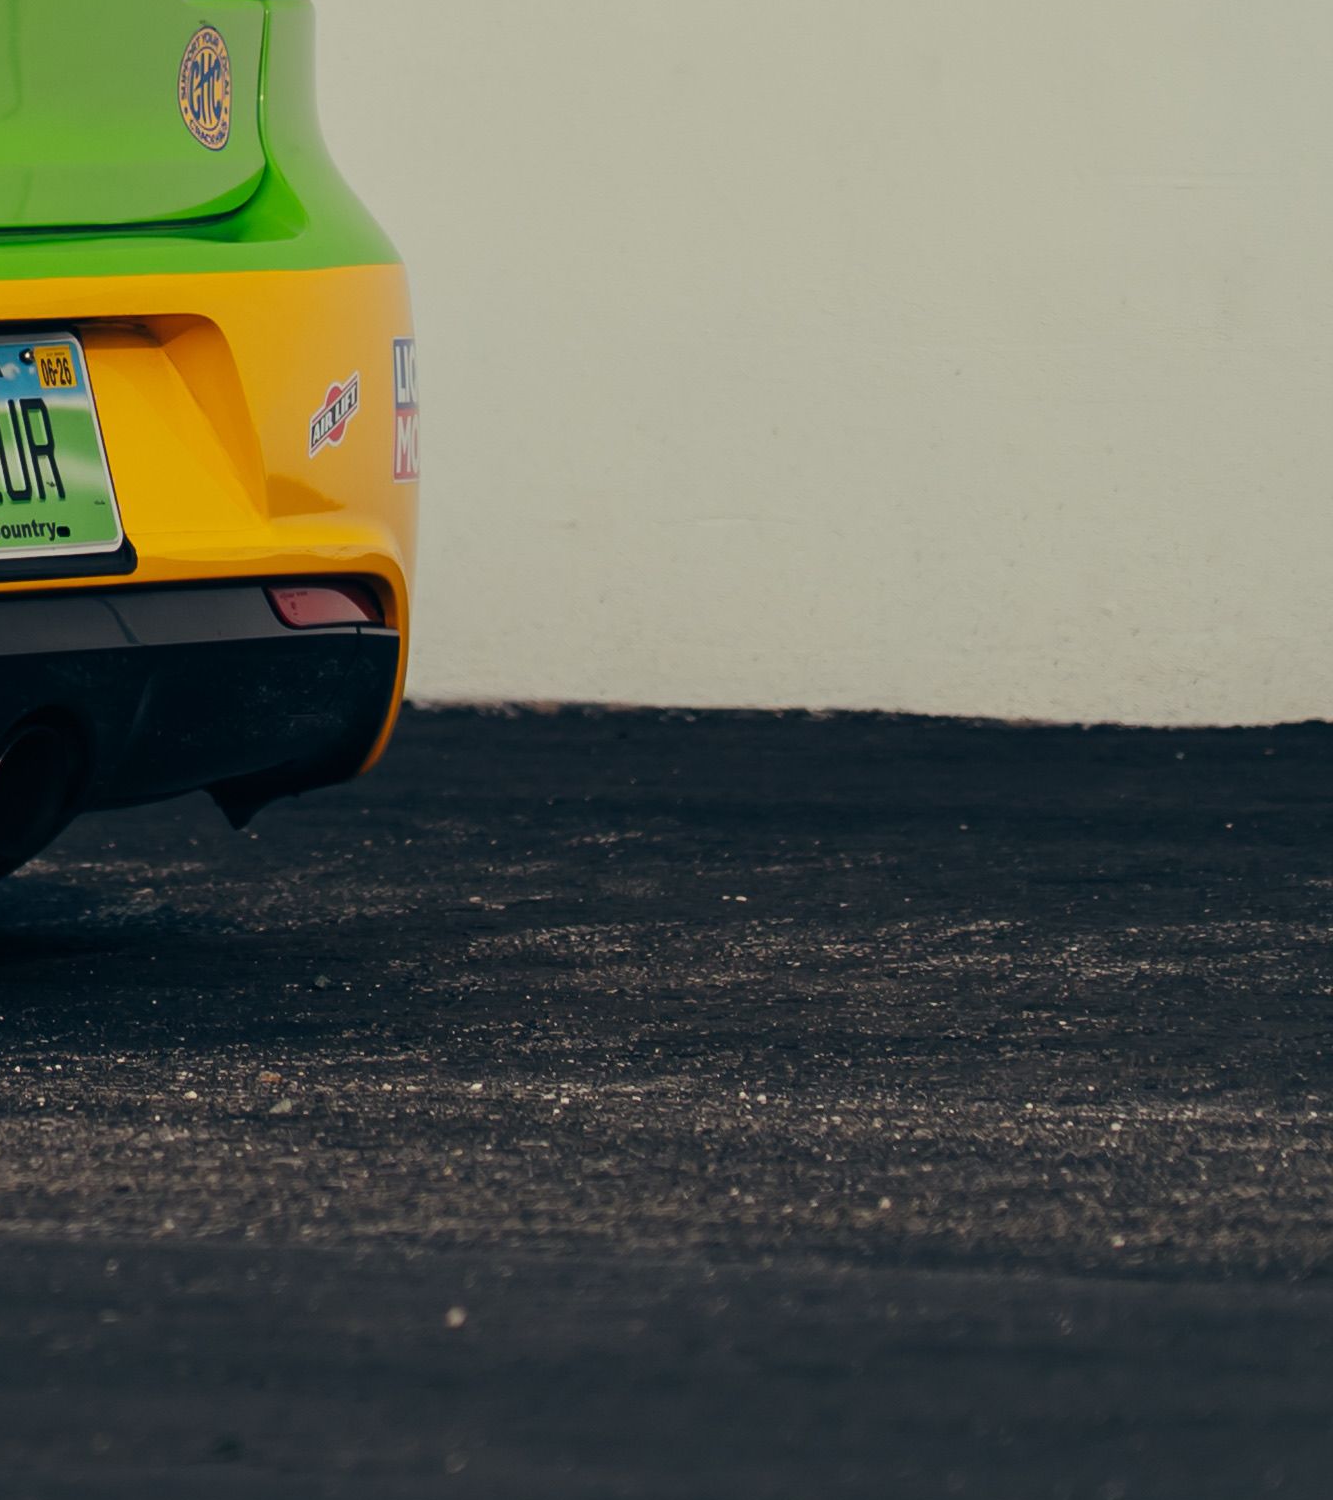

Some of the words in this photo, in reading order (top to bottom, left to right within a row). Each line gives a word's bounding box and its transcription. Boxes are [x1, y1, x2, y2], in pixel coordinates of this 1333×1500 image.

[40, 357, 72, 386] 06-26
[313, 410, 334, 445] AIR
[334, 384, 357, 420] LIFT
